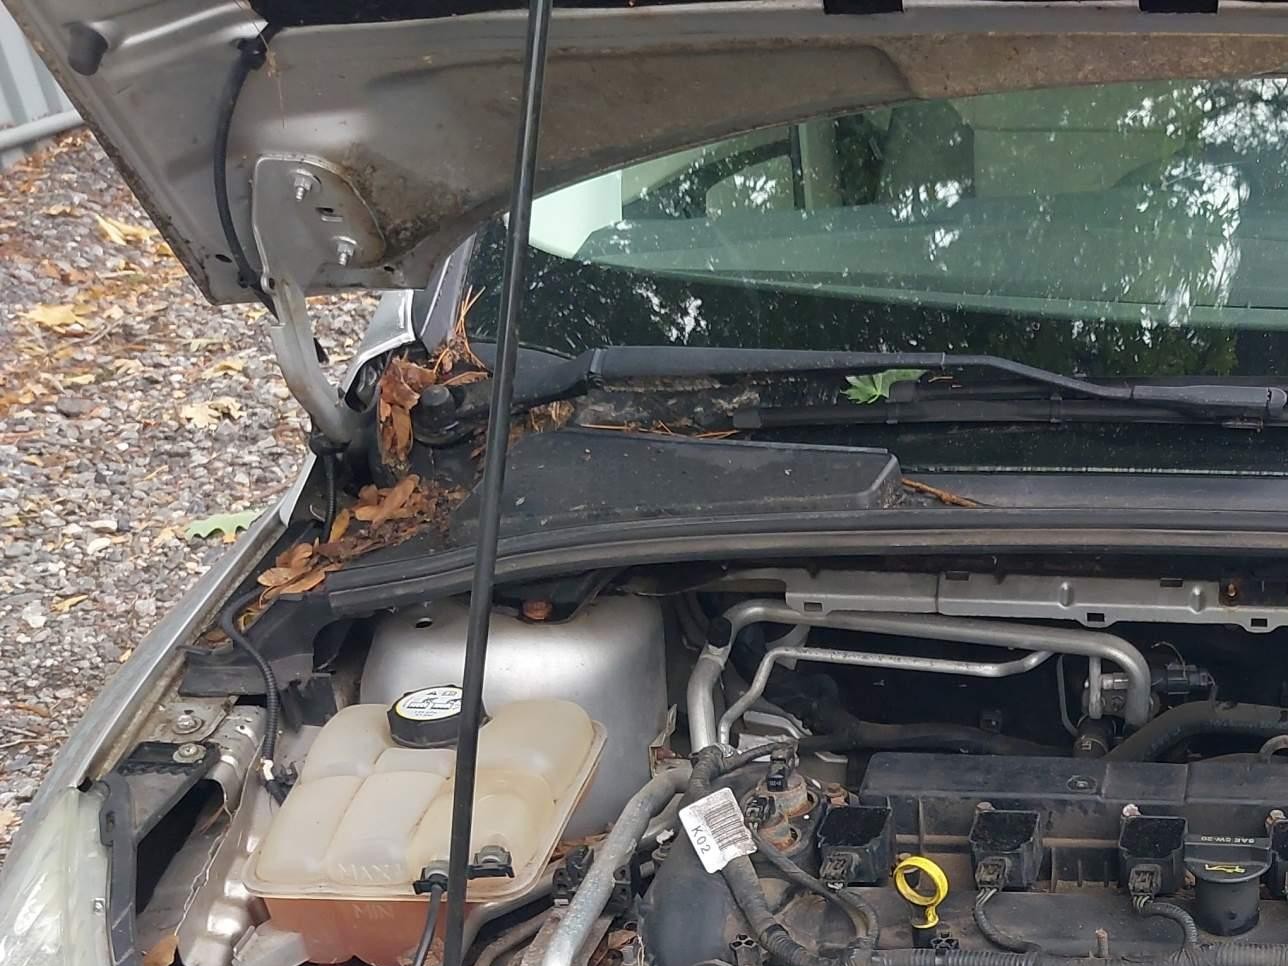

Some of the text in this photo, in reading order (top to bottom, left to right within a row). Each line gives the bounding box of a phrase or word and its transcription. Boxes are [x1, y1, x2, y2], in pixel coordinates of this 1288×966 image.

[691, 825, 711, 854] K02
[335, 863, 392, 881] MAX
[352, 903, 394, 919] MIN
